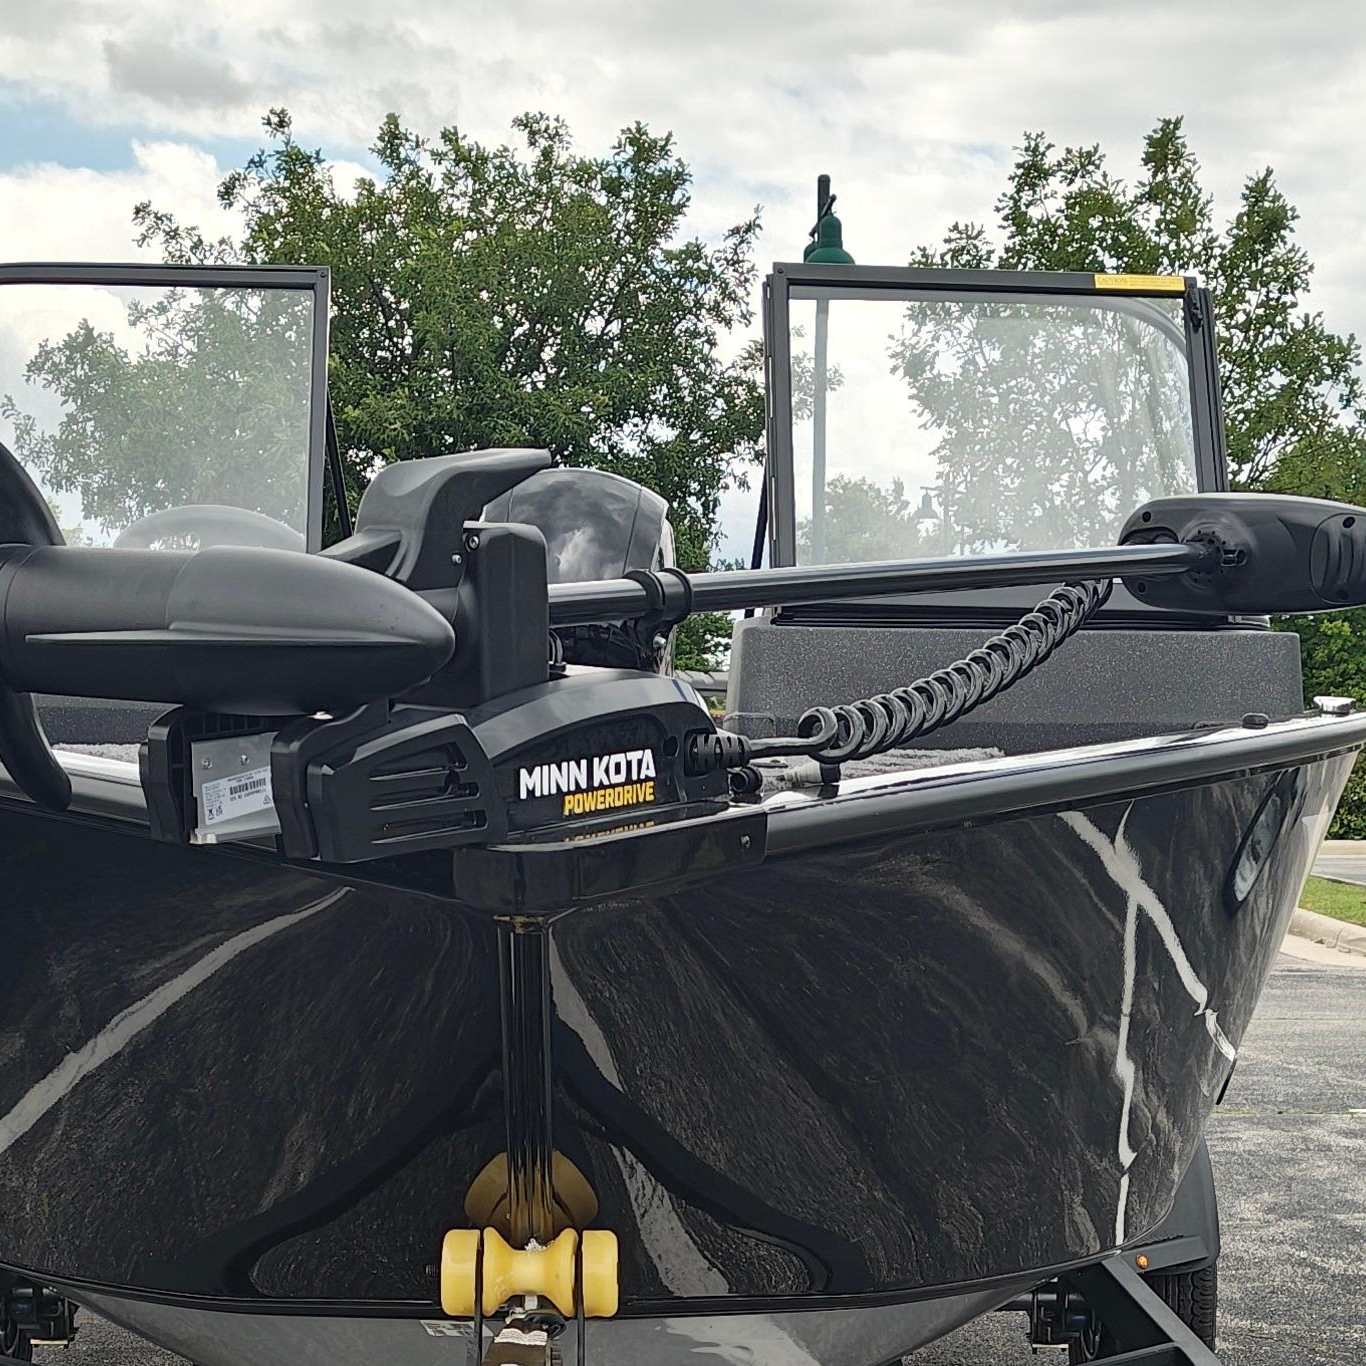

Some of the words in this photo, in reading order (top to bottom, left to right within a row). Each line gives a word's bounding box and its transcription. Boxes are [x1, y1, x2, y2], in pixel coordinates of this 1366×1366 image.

[519, 758, 588, 800] MINN
[592, 749, 657, 787] KOTA
[563, 780, 655, 816] POWERDRIVE
